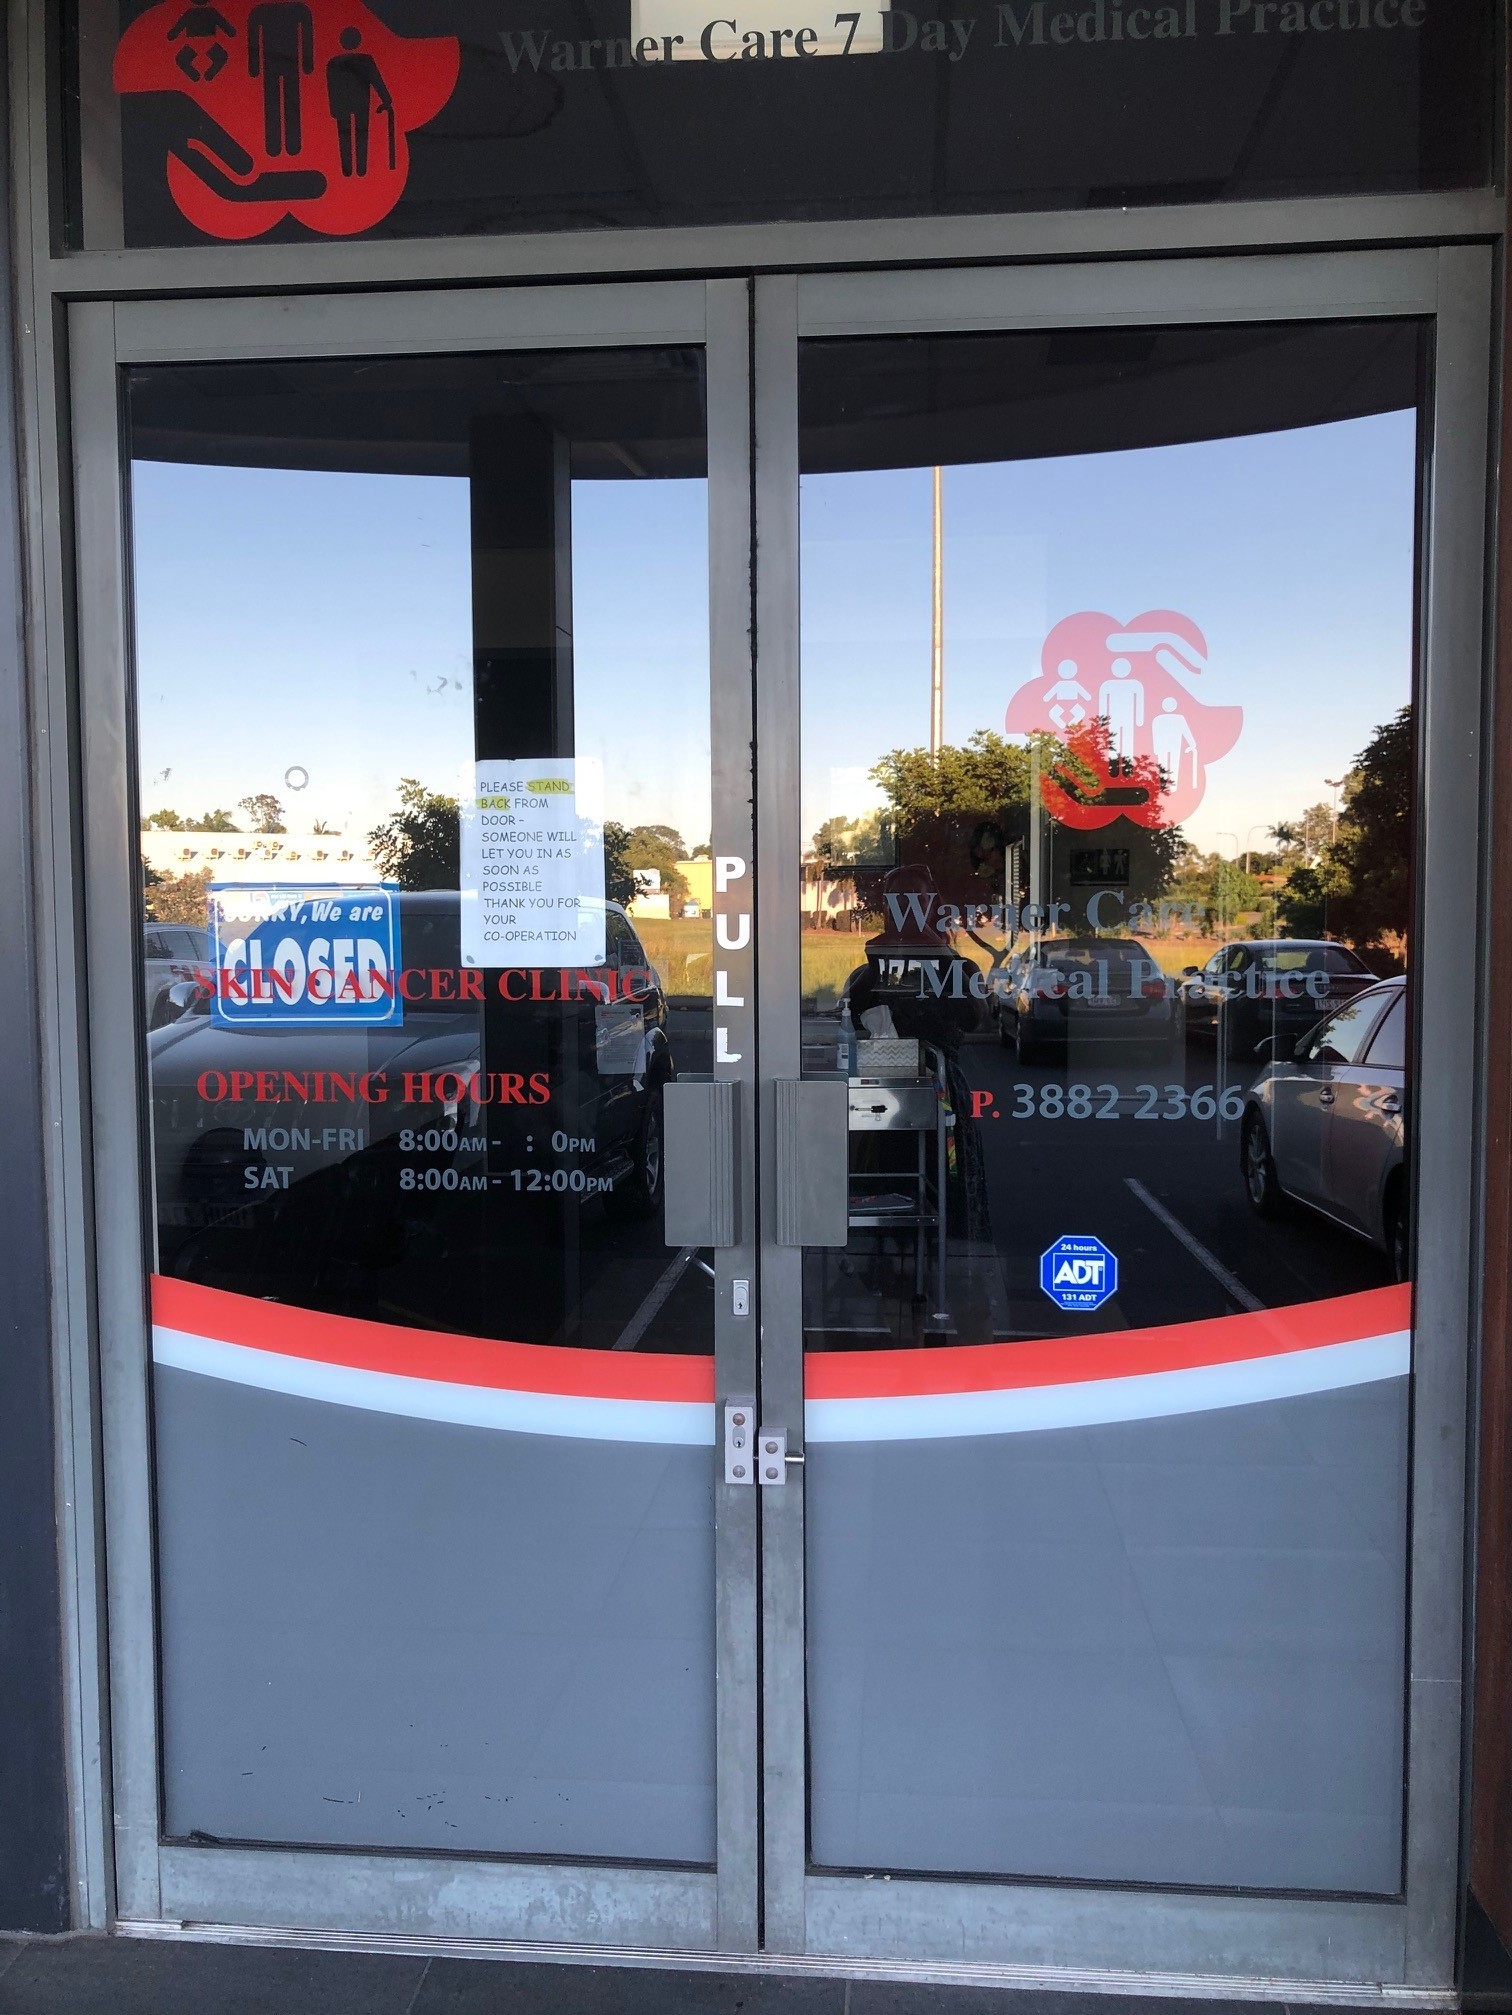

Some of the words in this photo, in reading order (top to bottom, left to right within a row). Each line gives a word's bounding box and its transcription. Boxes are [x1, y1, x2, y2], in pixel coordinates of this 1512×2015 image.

[500, 30, 684, 73] Warner
[700, 19, 820, 63] Care
[834, 12, 861, 56] 7
[878, 9, 978, 62] Day
[993, 0, 1198, 48] Medical
[1213, 0, 1427, 36] Practice
[480, 781, 524, 793] PLEASE
[527, 780, 570, 792] STAND
[481, 798, 511, 809] BACK
[514, 798, 549, 809] FROM
[481, 815, 516, 826] DOOR
[481, 831, 543, 843] SOMEONE
[546, 831, 578, 843] WILL
[481, 848, 504, 859] LET
[507, 848, 533, 859] YOU
[536, 848, 552, 859] IN
[555, 848, 572, 859] AS
[482, 865, 520, 876] SOON
[523, 865, 539, 876] AS
[482, 881, 543, 892] POSSIBLE
[484, 898, 526, 909] THANK
[528, 898, 554, 909] YOU
[557, 898, 581, 909] FOR
[311, 901, 343, 923] We
[349, 904, 384, 922] are
[883, 892, 1072, 933] Warner
[1086, 889, 1206, 932] Care
[483, 914, 517, 925] YOUR
[483, 931, 577, 942] CO-OPERATION
[715, 856, 751, 1063] PULL
[223, 937, 387, 1006] CLOSED
[194, 968, 298, 1000] SKIN
[306, 968, 487, 1001] CANCER
[498, 968, 651, 1002] CLINIC
[196, 1070, 390, 1103] OPENING
[401, 1072, 550, 1105] HOURS
[969, 1090, 1000, 1118] P.
[1011, 1083, 1120, 1120] 3882
[1134, 1084, 1245, 1121] 2366
[243, 1127, 364, 1151] MON-FRI
[243, 1165, 294, 1190] SAT
[1060, 1243, 1072, 1251] 24
[1073, 1243, 1098, 1252] hours
[1053, 1259, 1105, 1286] ADT
[1061, 1293, 1077, 1301] 131
[1078, 1293, 1098, 1302] ADT
